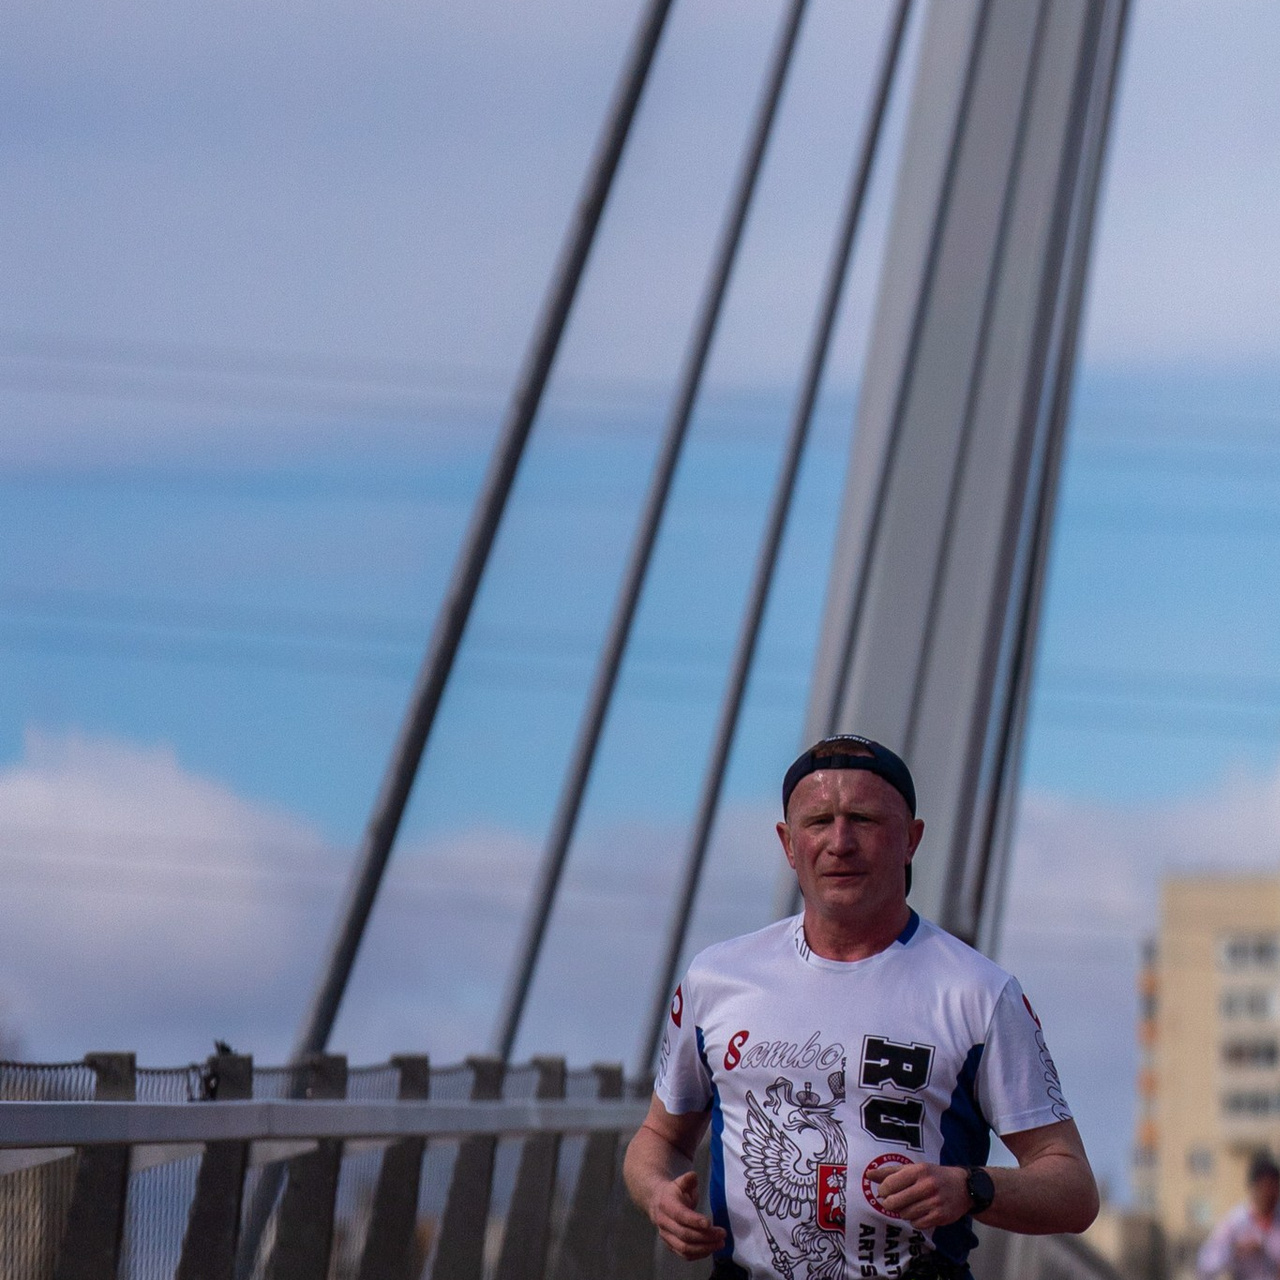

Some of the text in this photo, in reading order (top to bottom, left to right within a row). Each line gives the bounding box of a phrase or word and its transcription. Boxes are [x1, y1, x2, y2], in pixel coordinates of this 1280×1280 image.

[723, 1030, 845, 1071] Sambo
[863, 1162, 878, 1206] СМБО
[858, 1223, 878, 1277] ARTS
